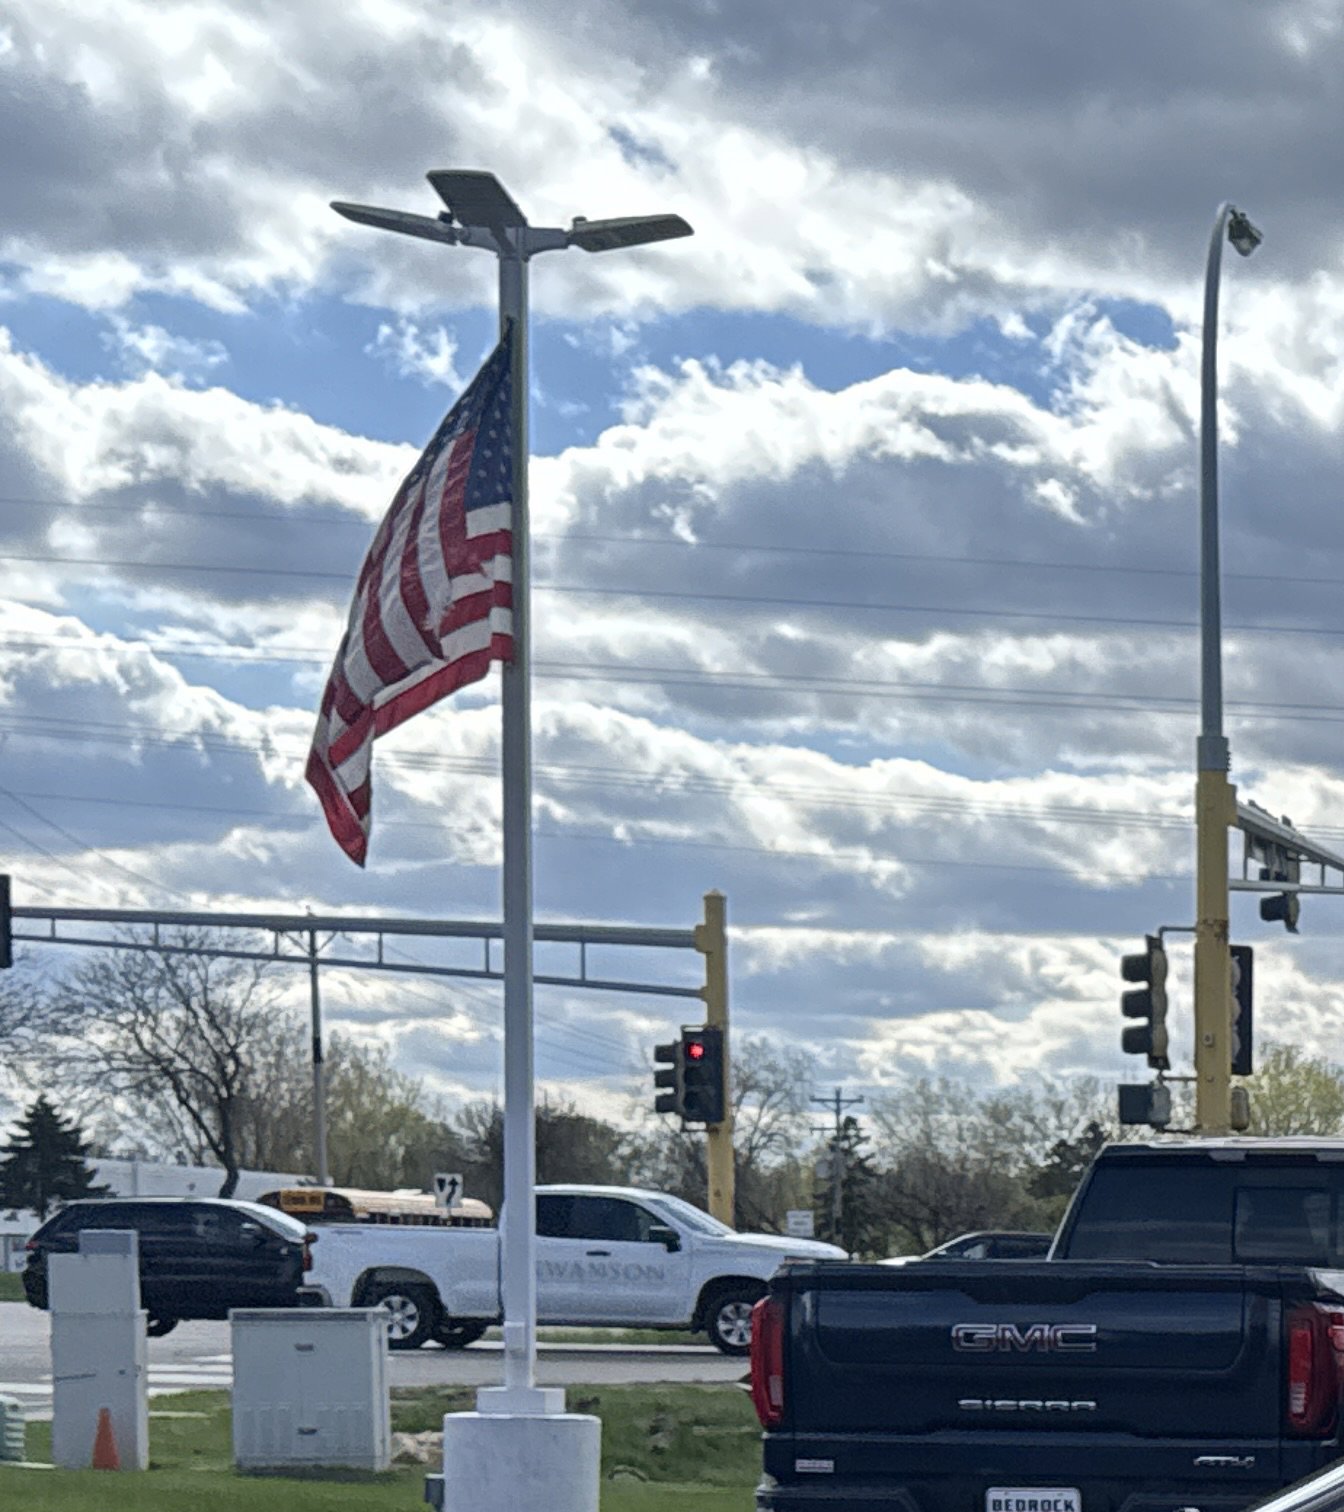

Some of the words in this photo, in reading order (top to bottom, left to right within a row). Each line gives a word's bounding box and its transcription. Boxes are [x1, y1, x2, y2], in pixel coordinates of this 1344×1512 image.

[951, 1323, 1097, 1352] GMC
[957, 1399, 1097, 1412] SIERRA
[992, 1499, 1075, 1512] BEDROCK
